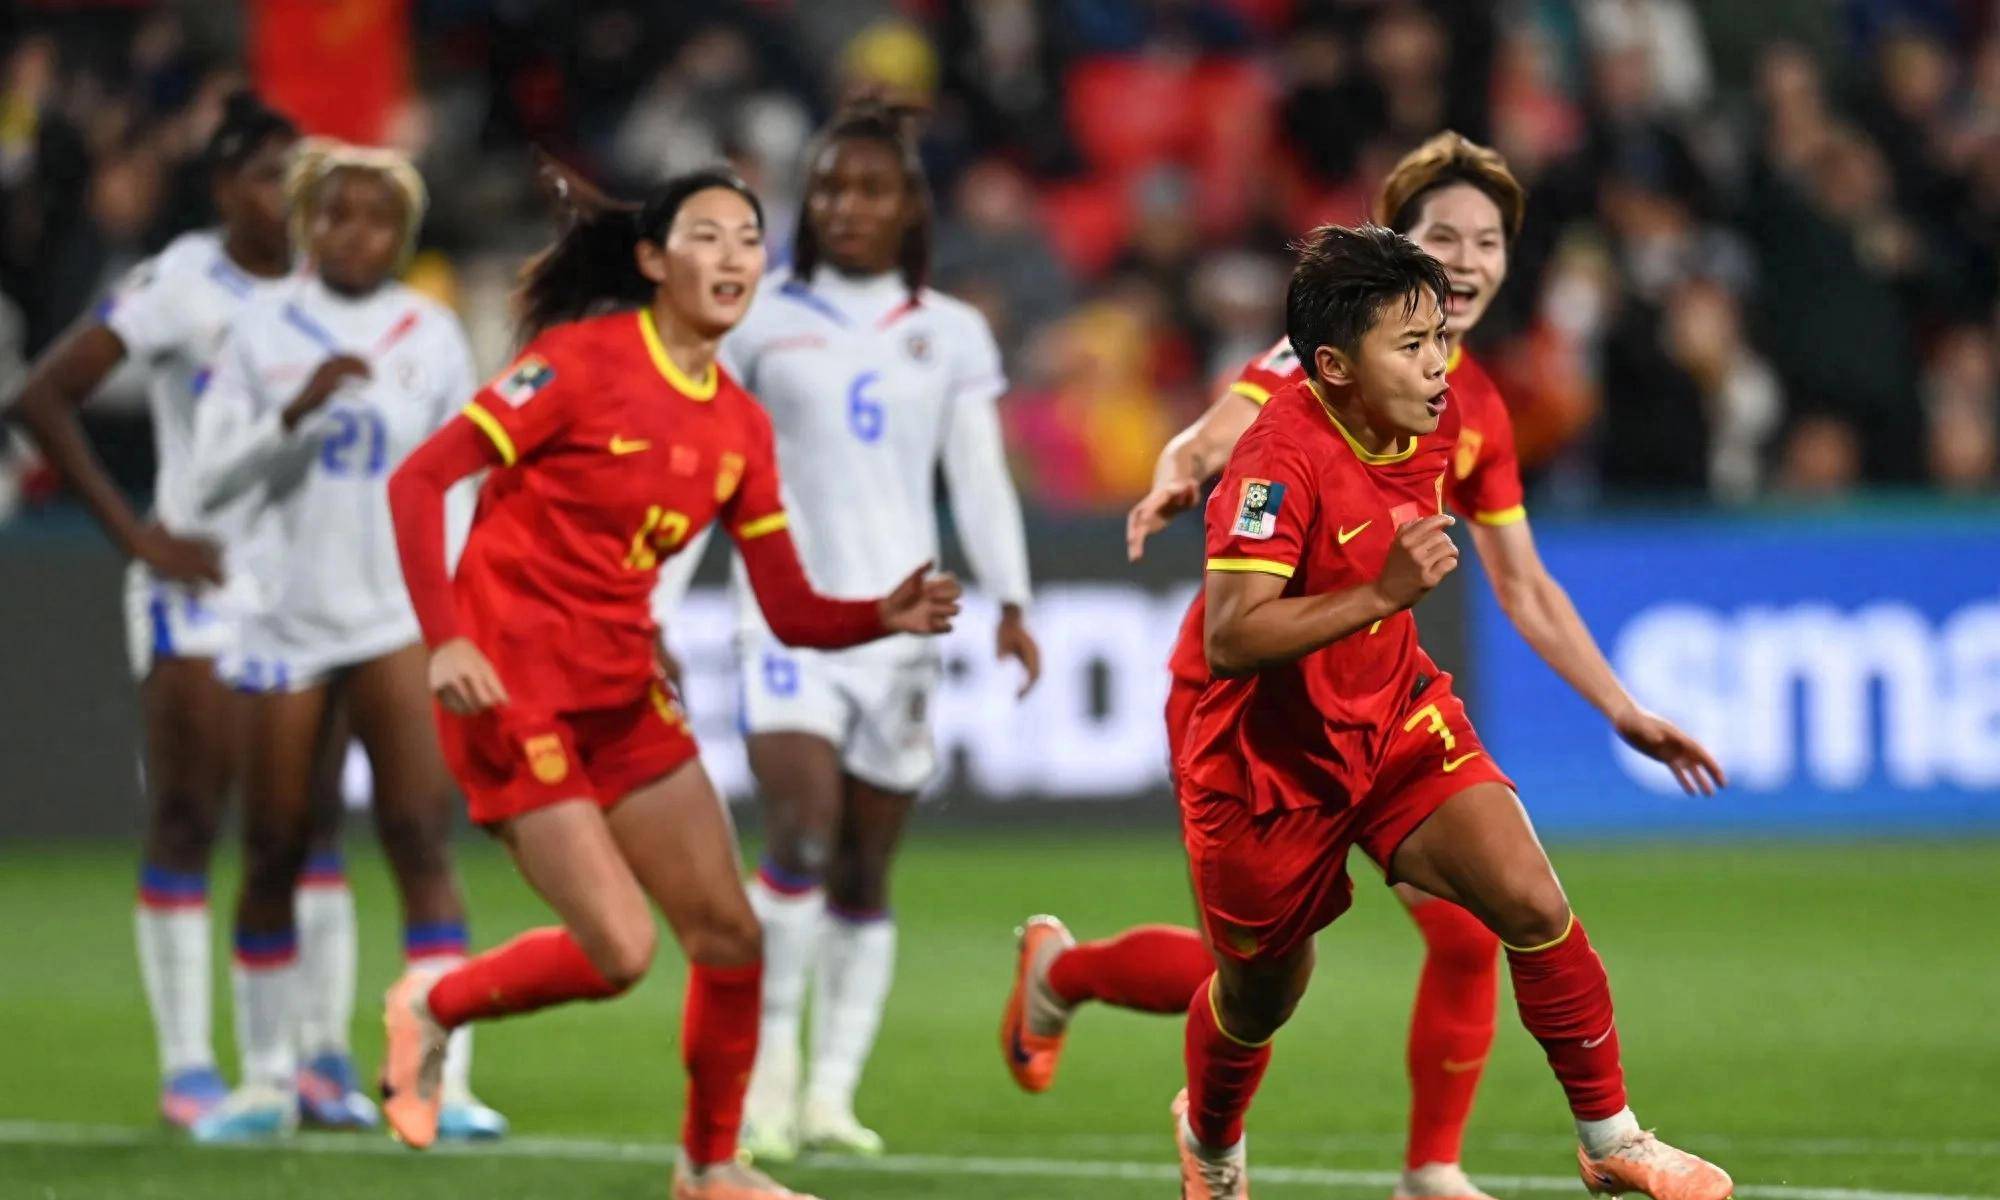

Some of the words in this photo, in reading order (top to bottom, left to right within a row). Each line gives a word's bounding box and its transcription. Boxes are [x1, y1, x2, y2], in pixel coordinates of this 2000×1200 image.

[320, 404, 388, 478] 21
[847, 370, 888, 445] 6
[1403, 703, 1456, 751] 7
